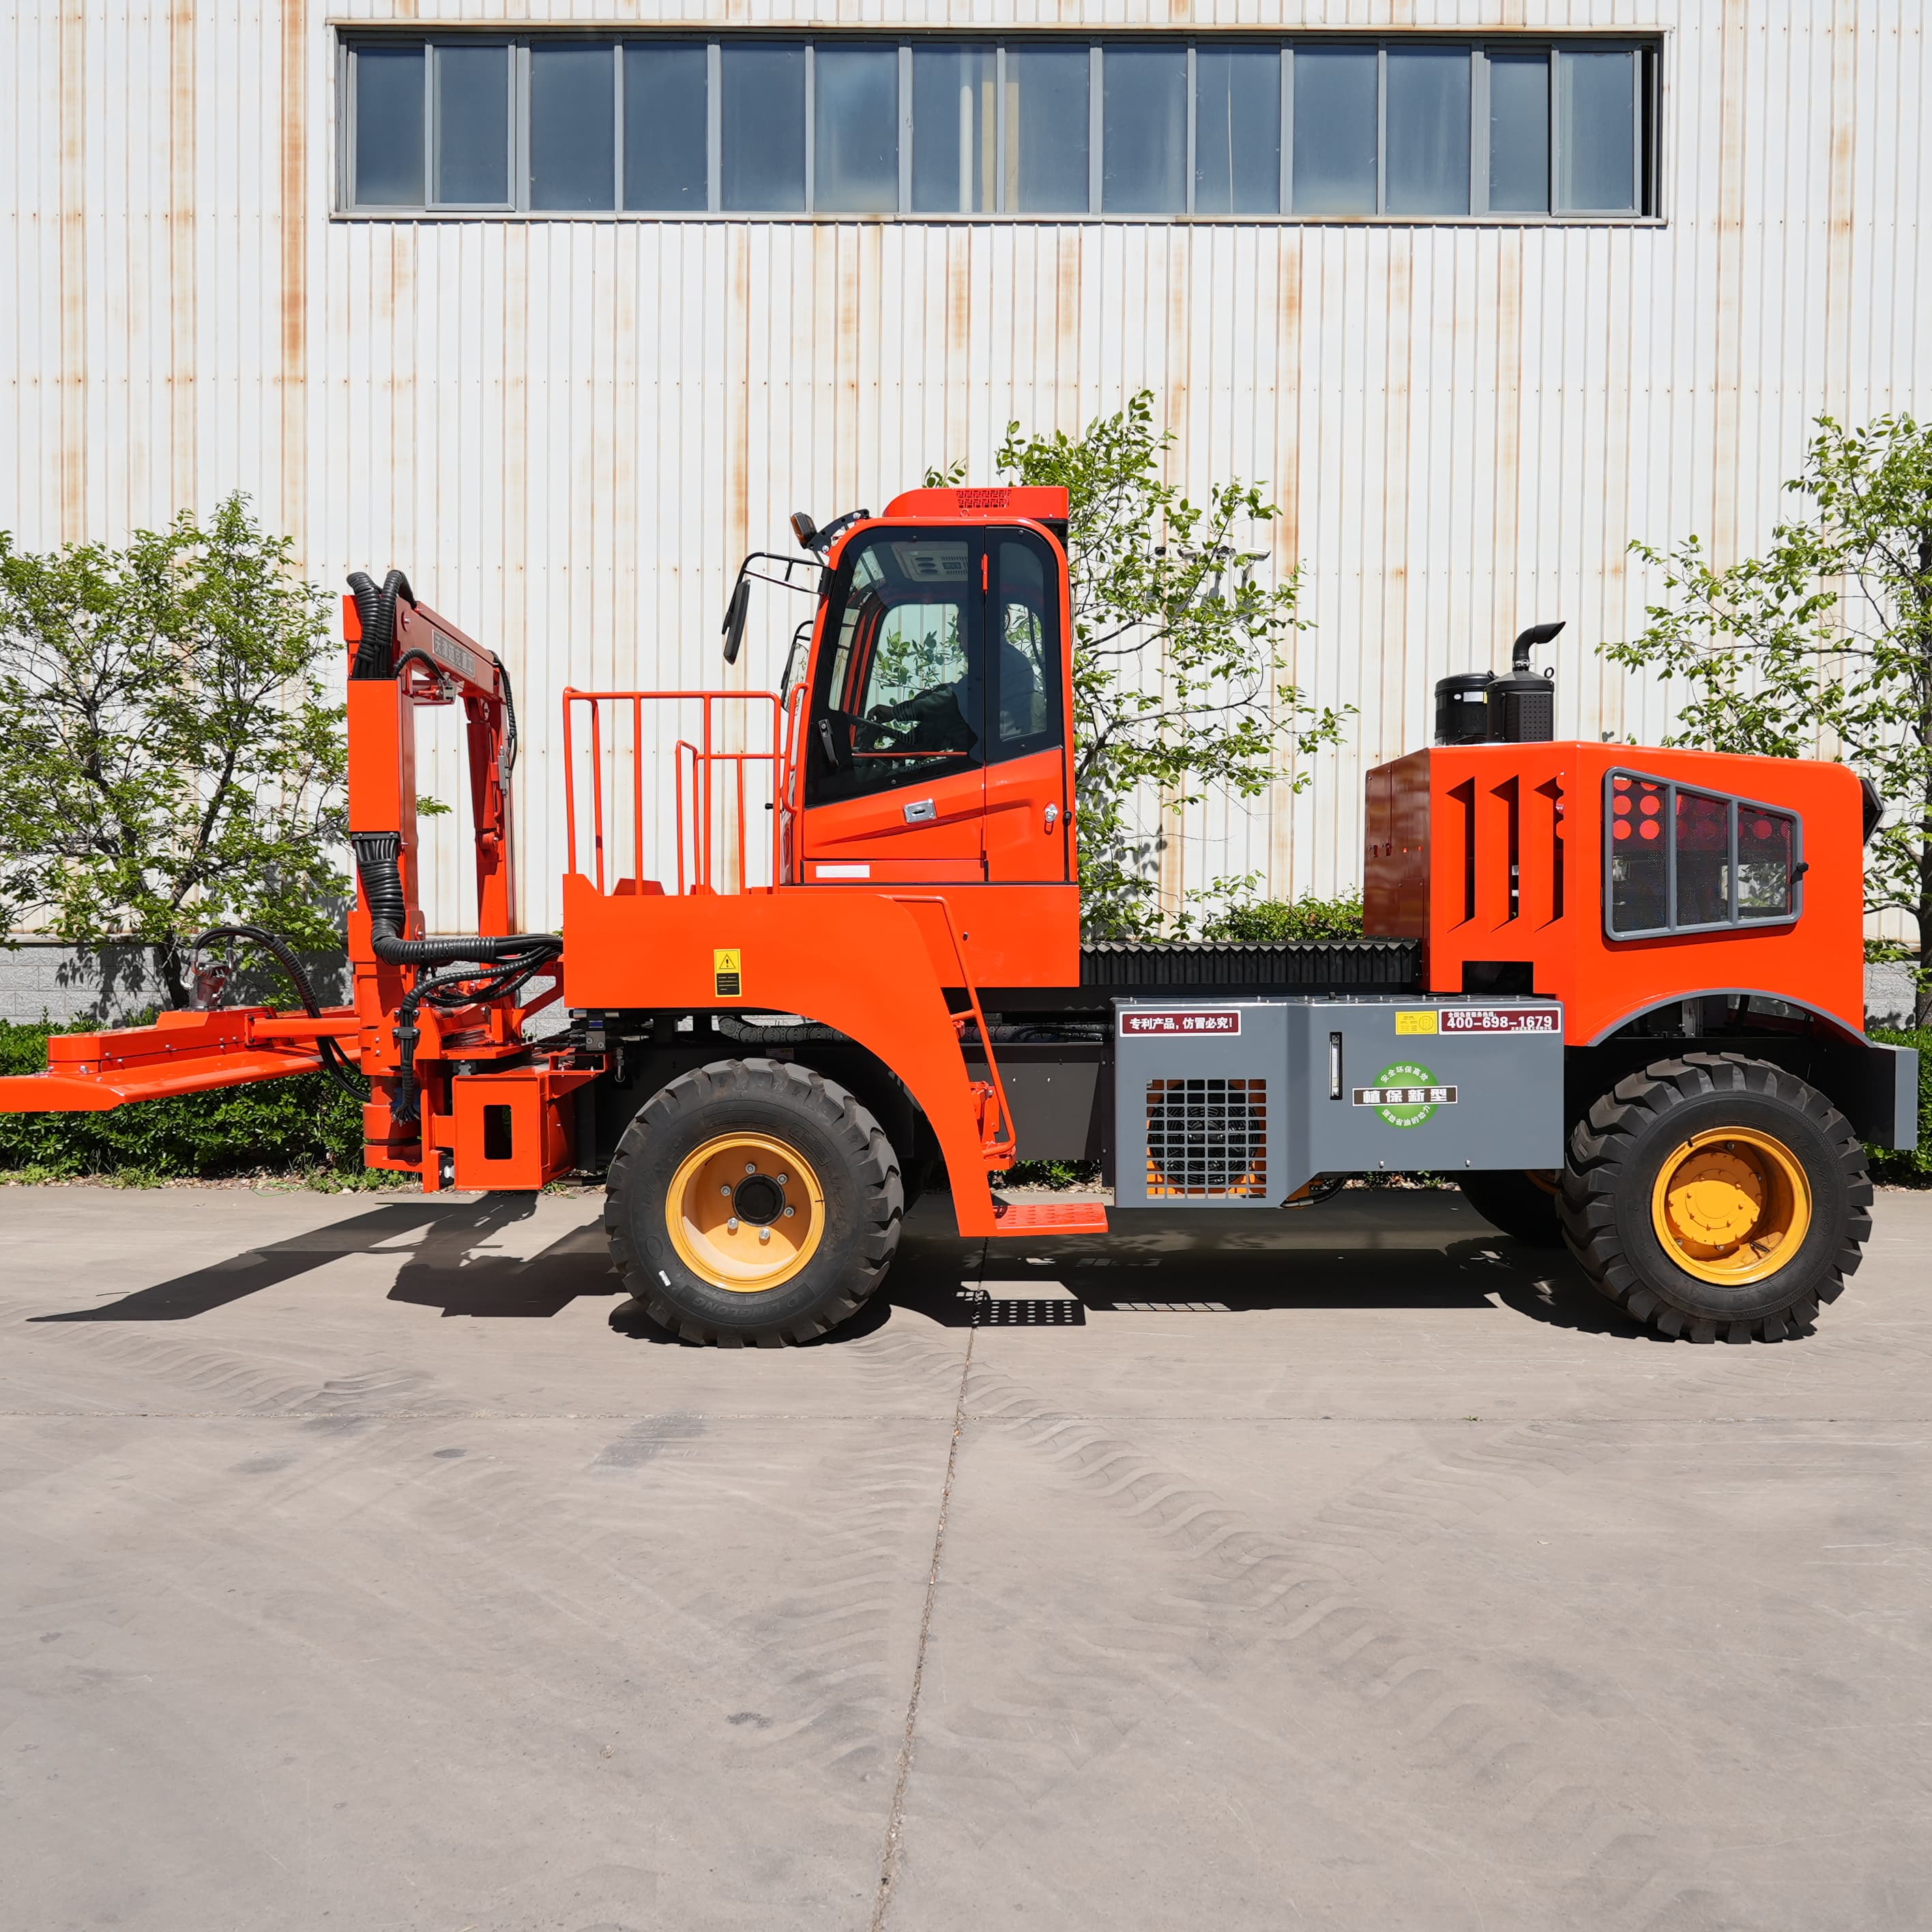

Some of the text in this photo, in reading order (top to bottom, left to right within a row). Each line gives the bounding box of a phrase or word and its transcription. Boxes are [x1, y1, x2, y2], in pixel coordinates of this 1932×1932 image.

[1129, 1016, 1233, 1029] 专利产品，仿冒必究！
[1447, 1016, 1552, 1029] 400-698-1679
[1380, 1066, 1429, 1083] 安全环保高效
[1362, 1088, 1447, 1103] 植保新型
